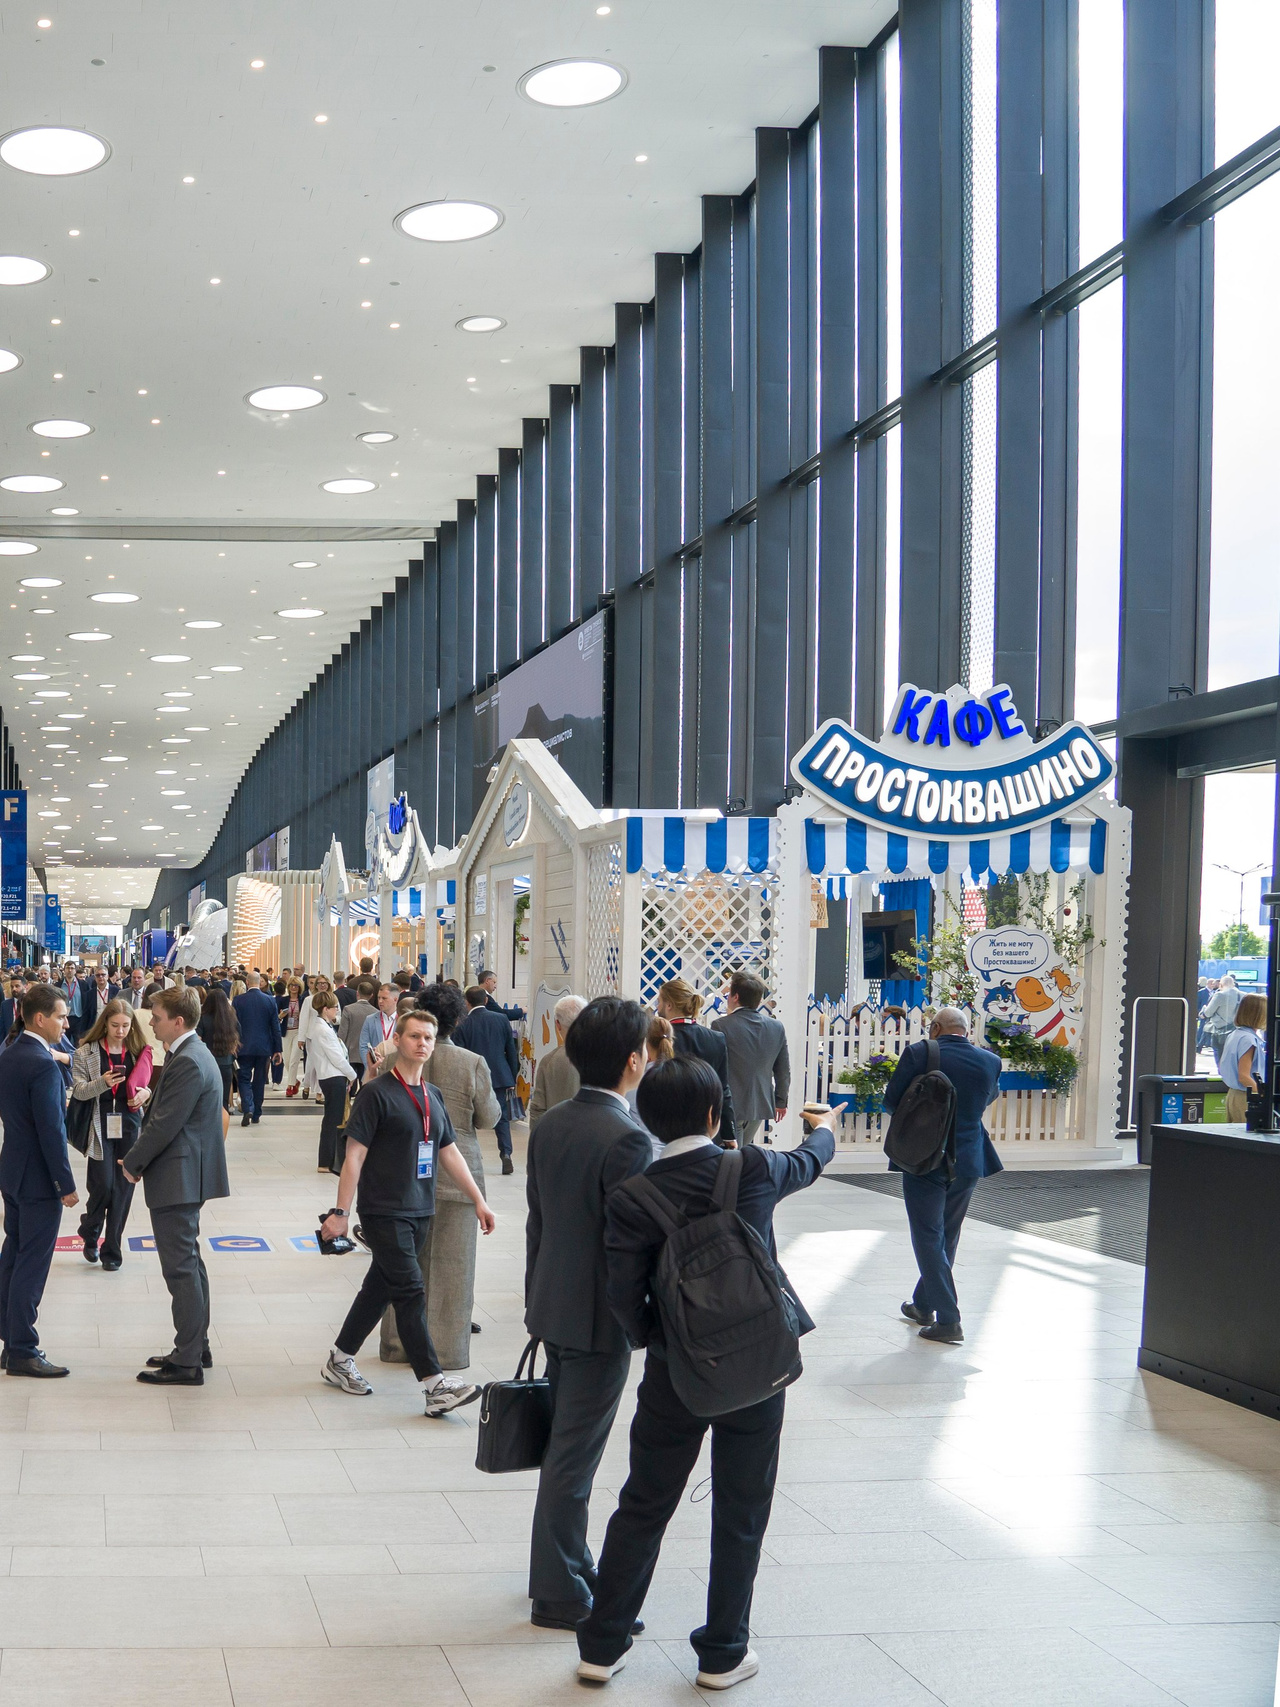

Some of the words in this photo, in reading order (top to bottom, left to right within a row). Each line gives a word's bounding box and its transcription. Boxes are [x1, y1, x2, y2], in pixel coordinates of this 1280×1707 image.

[892, 688, 1024, 747] КАФЕ
[809, 734, 1101, 823] ПРОСТОКВАШИНО
[4, 797, 19, 821] F
[47, 897, 57, 907] G
[988, 938, 1008, 947] Жить
[1018, 941, 1034, 949] могу
[983, 957, 1037, 967] Простоквашино!
[216, 1239, 262, 1248] G
